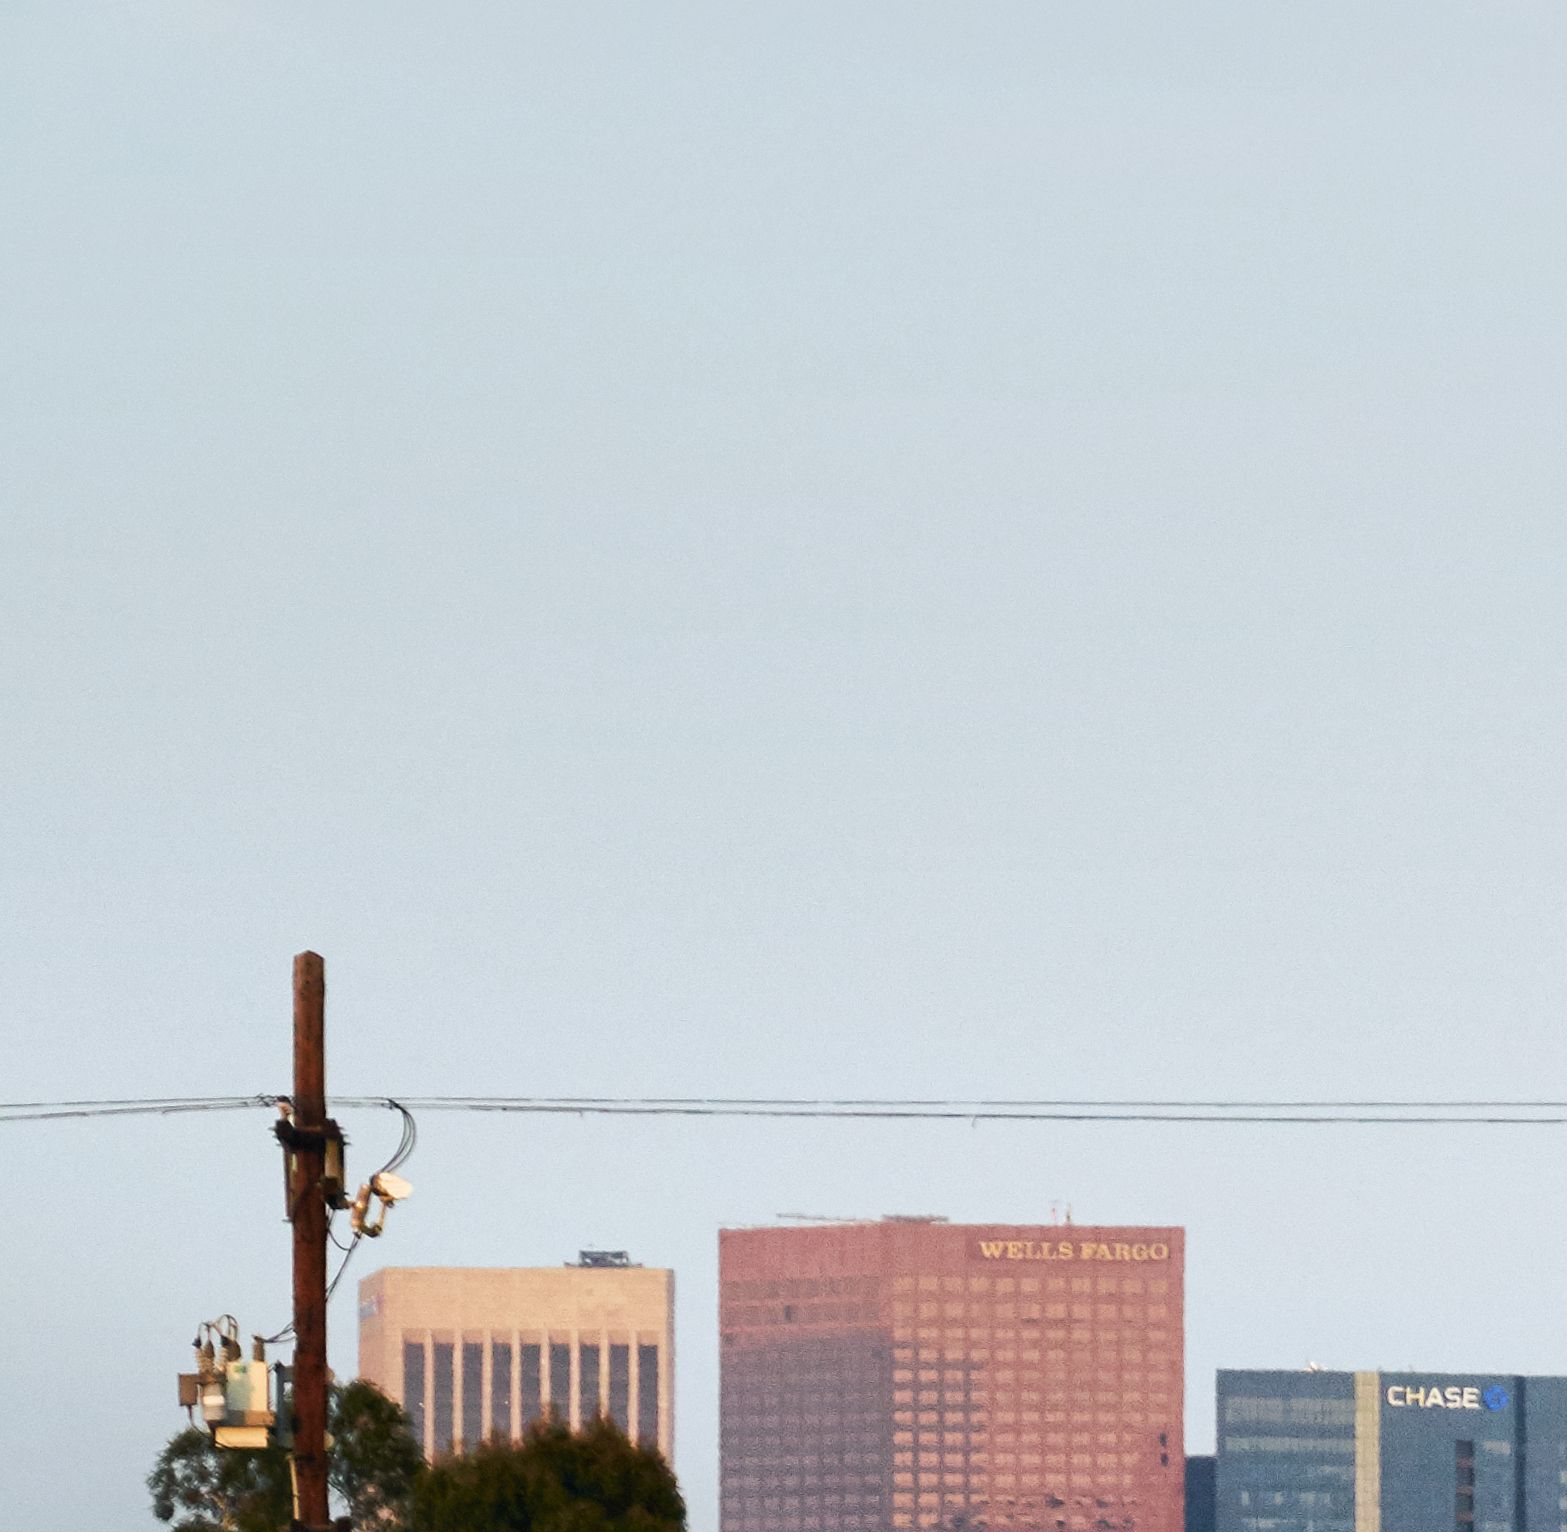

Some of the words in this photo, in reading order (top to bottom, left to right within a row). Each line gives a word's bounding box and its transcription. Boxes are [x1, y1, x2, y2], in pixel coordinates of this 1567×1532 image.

[979, 1241, 1074, 1260] WELLS
[1079, 1242, 1169, 1261] FARGO
[1386, 1385, 1482, 1410] CHASE
